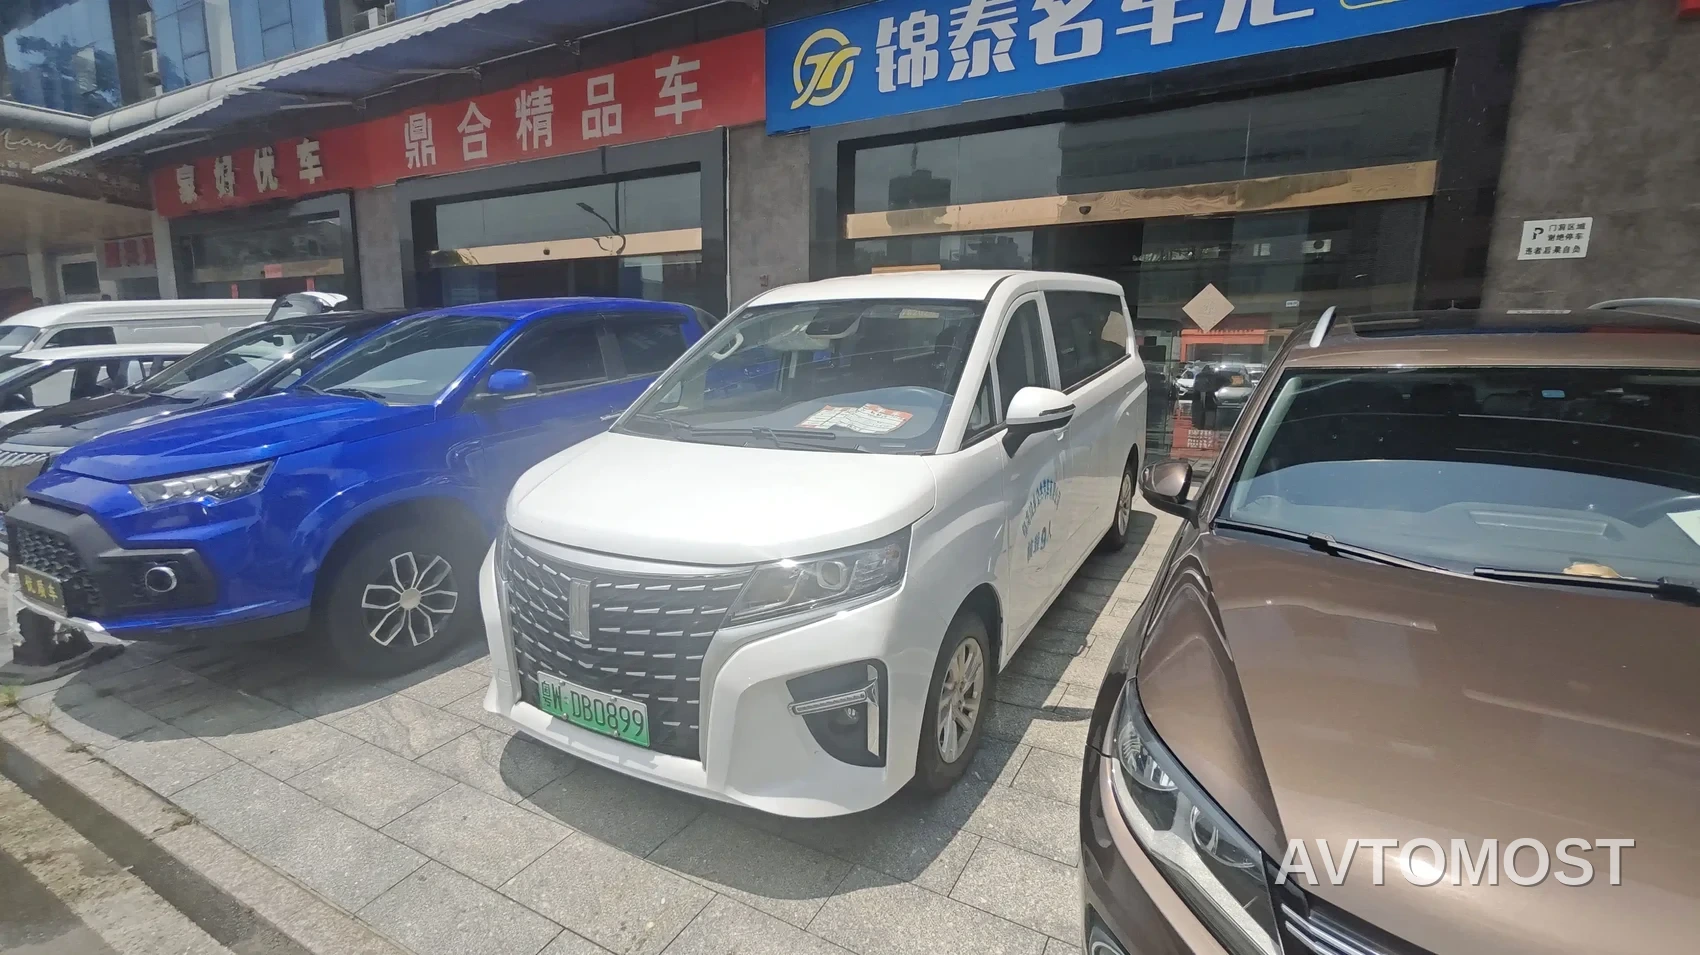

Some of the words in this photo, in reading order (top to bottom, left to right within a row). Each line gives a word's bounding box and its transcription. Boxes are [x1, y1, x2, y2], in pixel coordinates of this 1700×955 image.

[404, 55, 703, 170] 鼎合精品车
